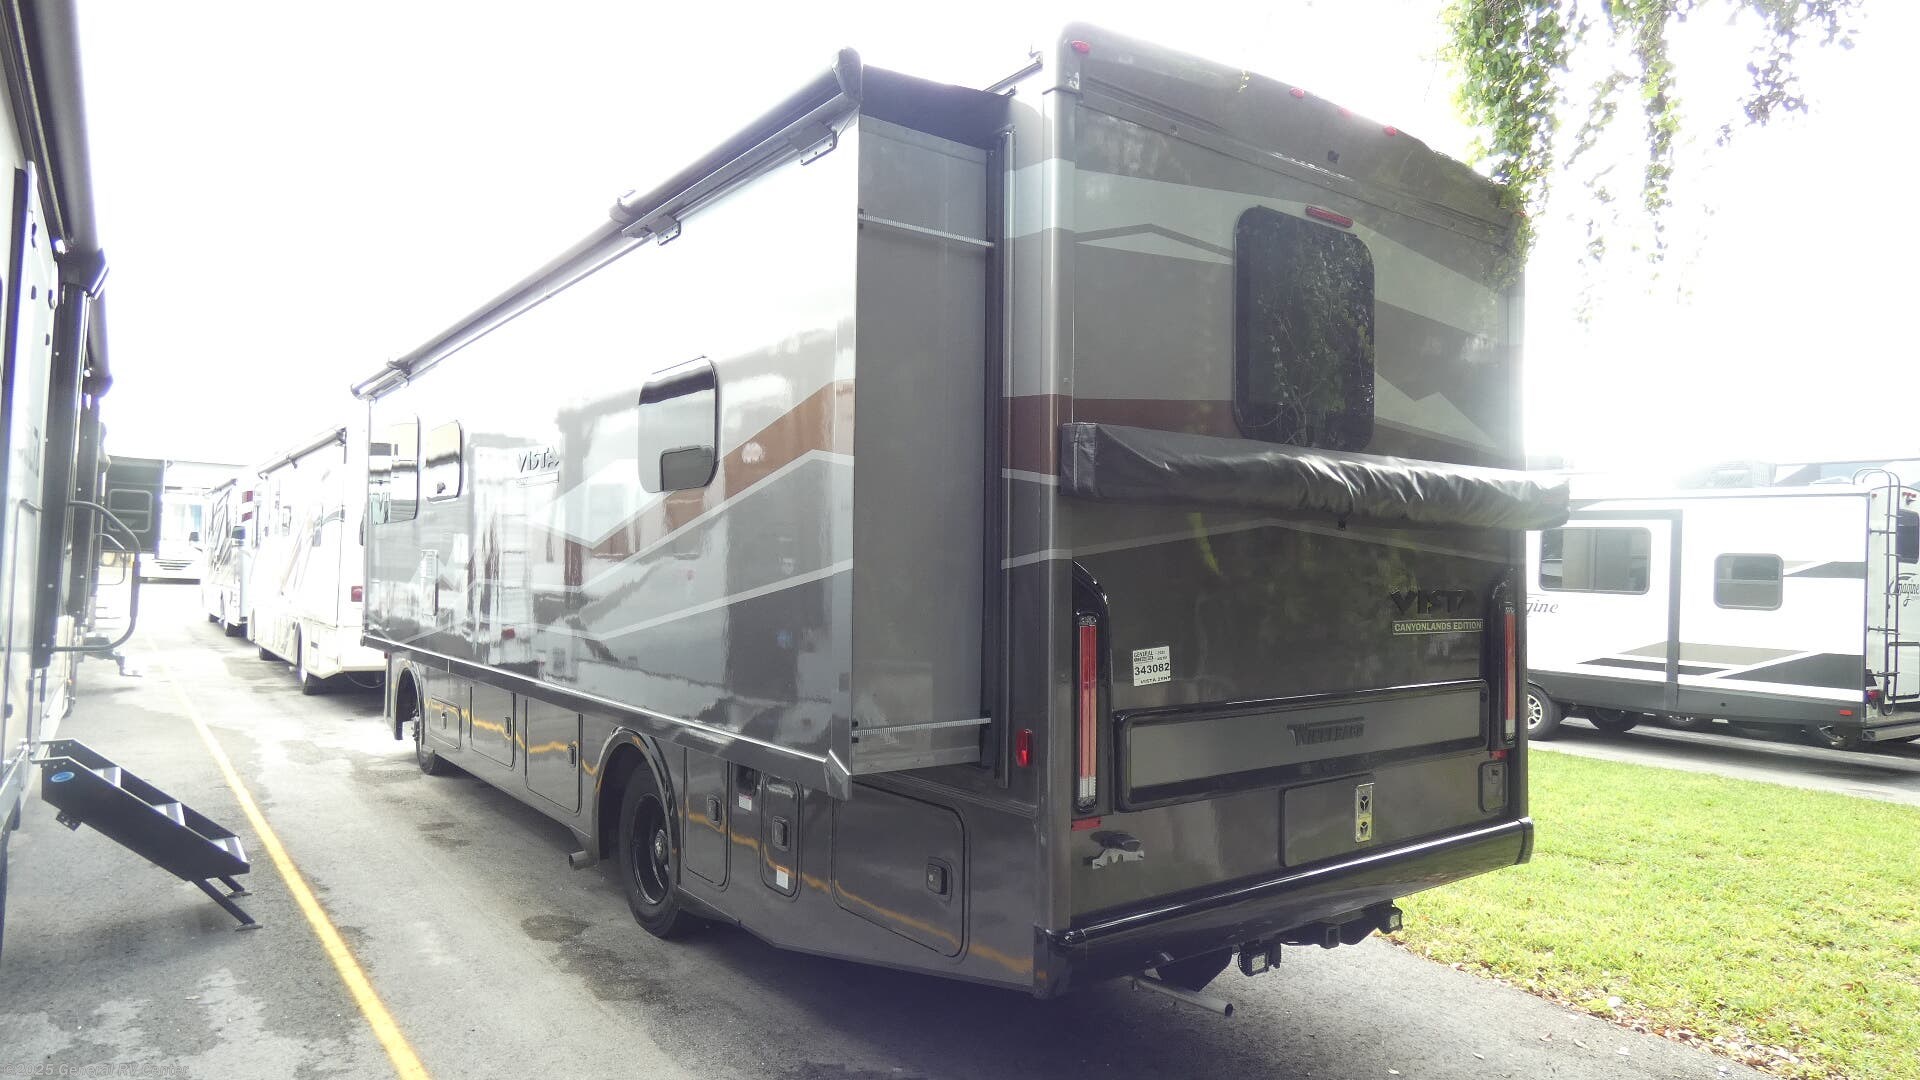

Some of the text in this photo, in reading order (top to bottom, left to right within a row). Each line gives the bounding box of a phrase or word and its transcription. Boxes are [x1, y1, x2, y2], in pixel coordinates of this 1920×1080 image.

[518, 446, 560, 473] VISTA
[1394, 620, 1482, 632] CANYONLANDS EDITION
[1134, 662, 1170, 676] 343082
